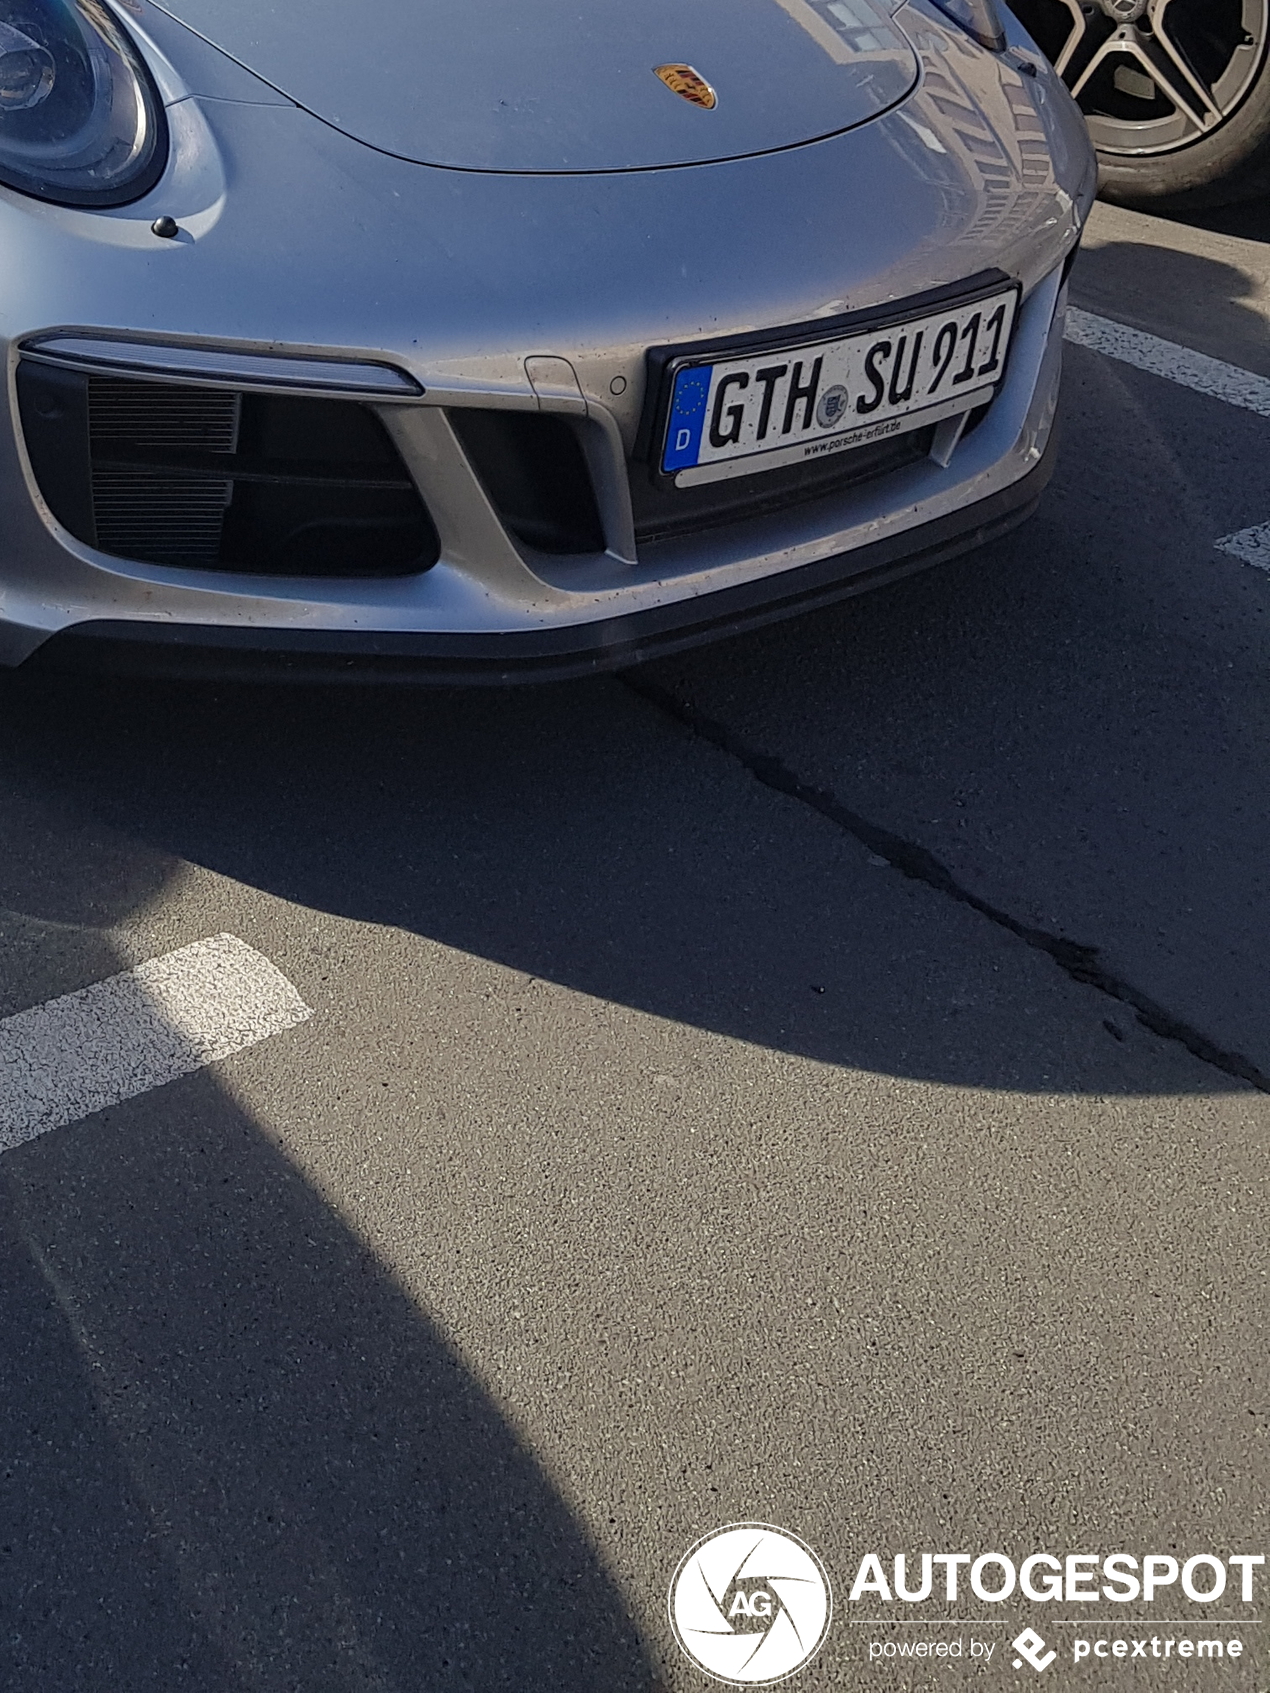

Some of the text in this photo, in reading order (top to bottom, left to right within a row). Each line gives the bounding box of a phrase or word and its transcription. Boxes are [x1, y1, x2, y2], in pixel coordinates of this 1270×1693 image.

[676, 303, 1007, 451] D GTH SU 911
